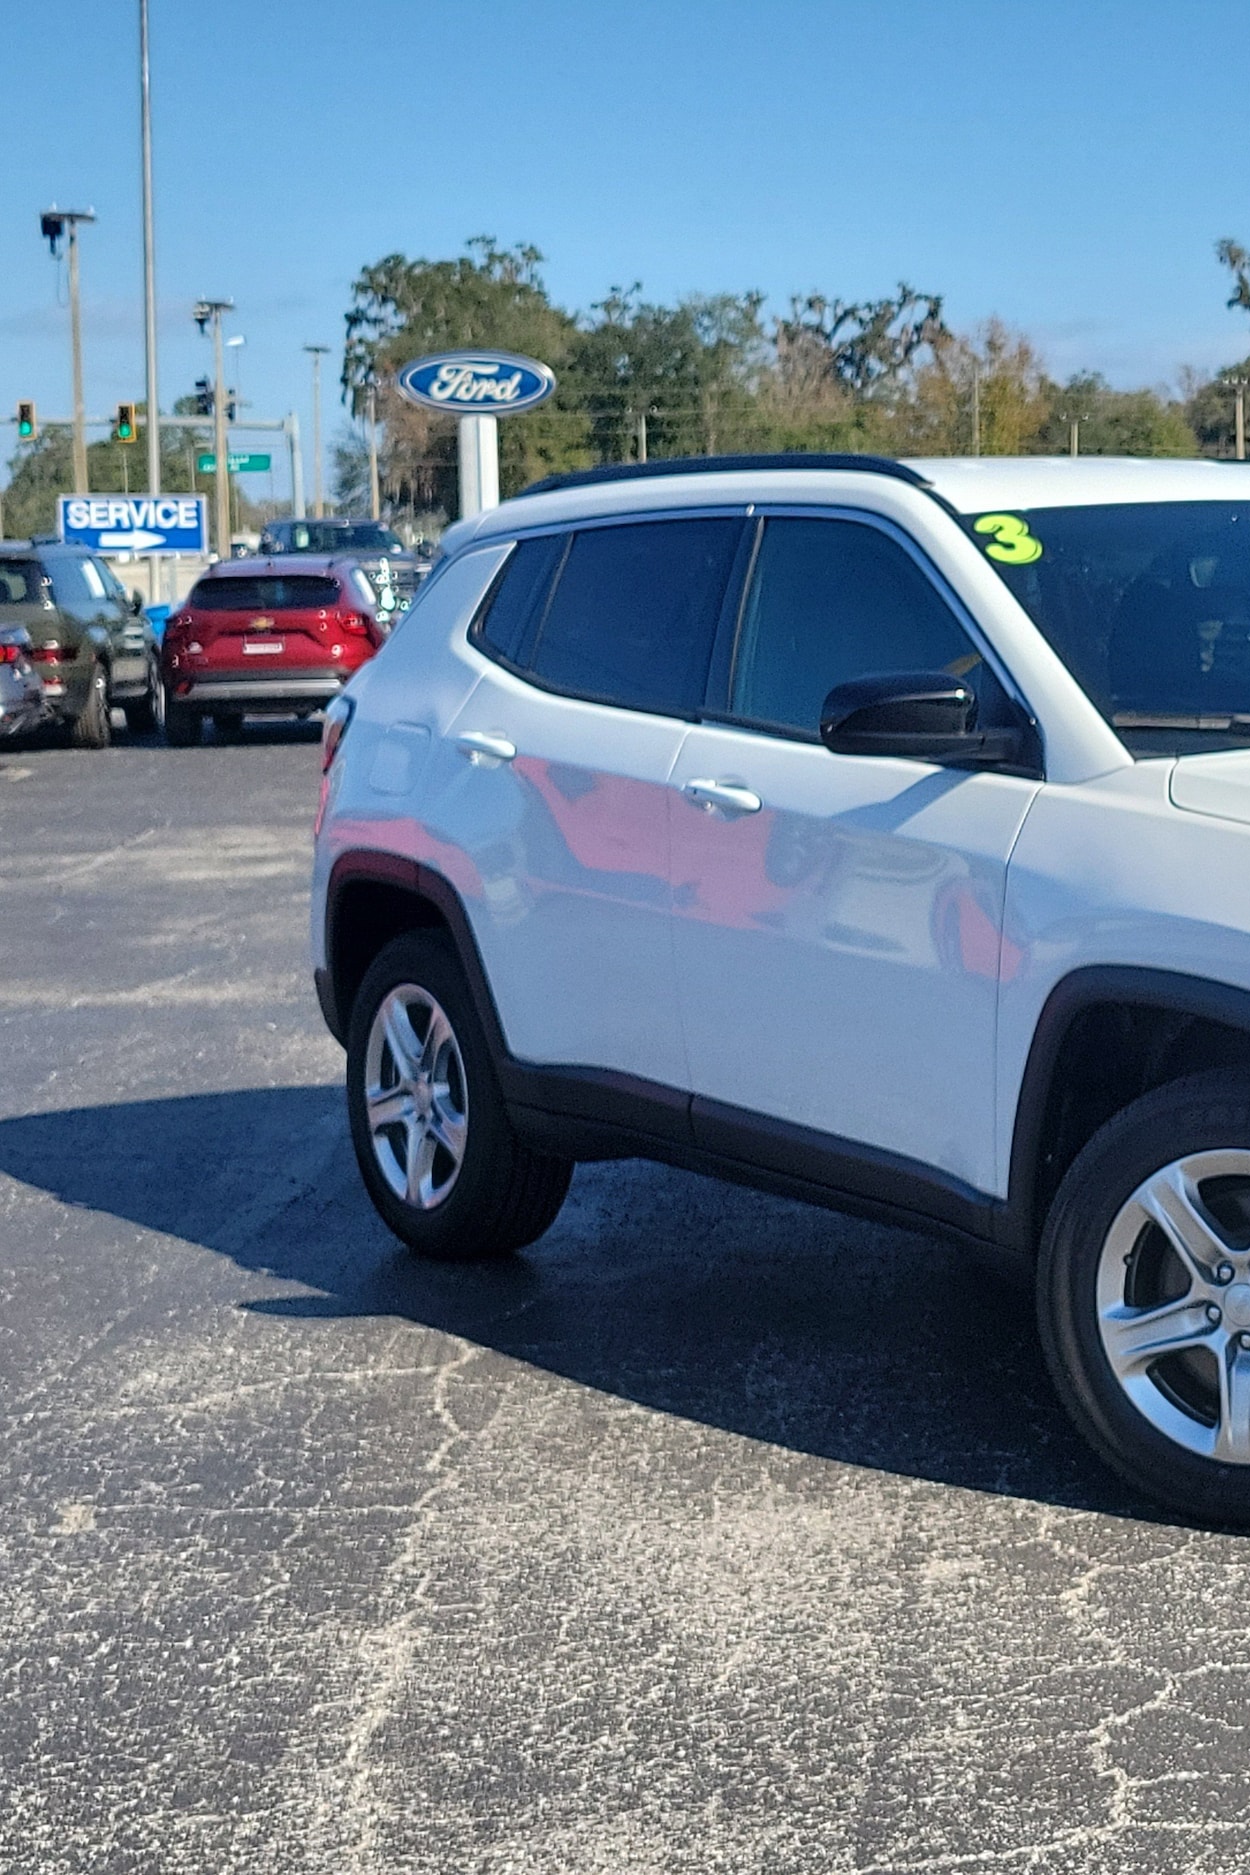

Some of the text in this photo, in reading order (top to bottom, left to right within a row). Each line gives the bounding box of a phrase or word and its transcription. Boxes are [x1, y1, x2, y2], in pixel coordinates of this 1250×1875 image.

[429, 364, 522, 401] Ford
[67, 500, 199, 529] SERVICE
[974, 513, 1042, 564] 3
